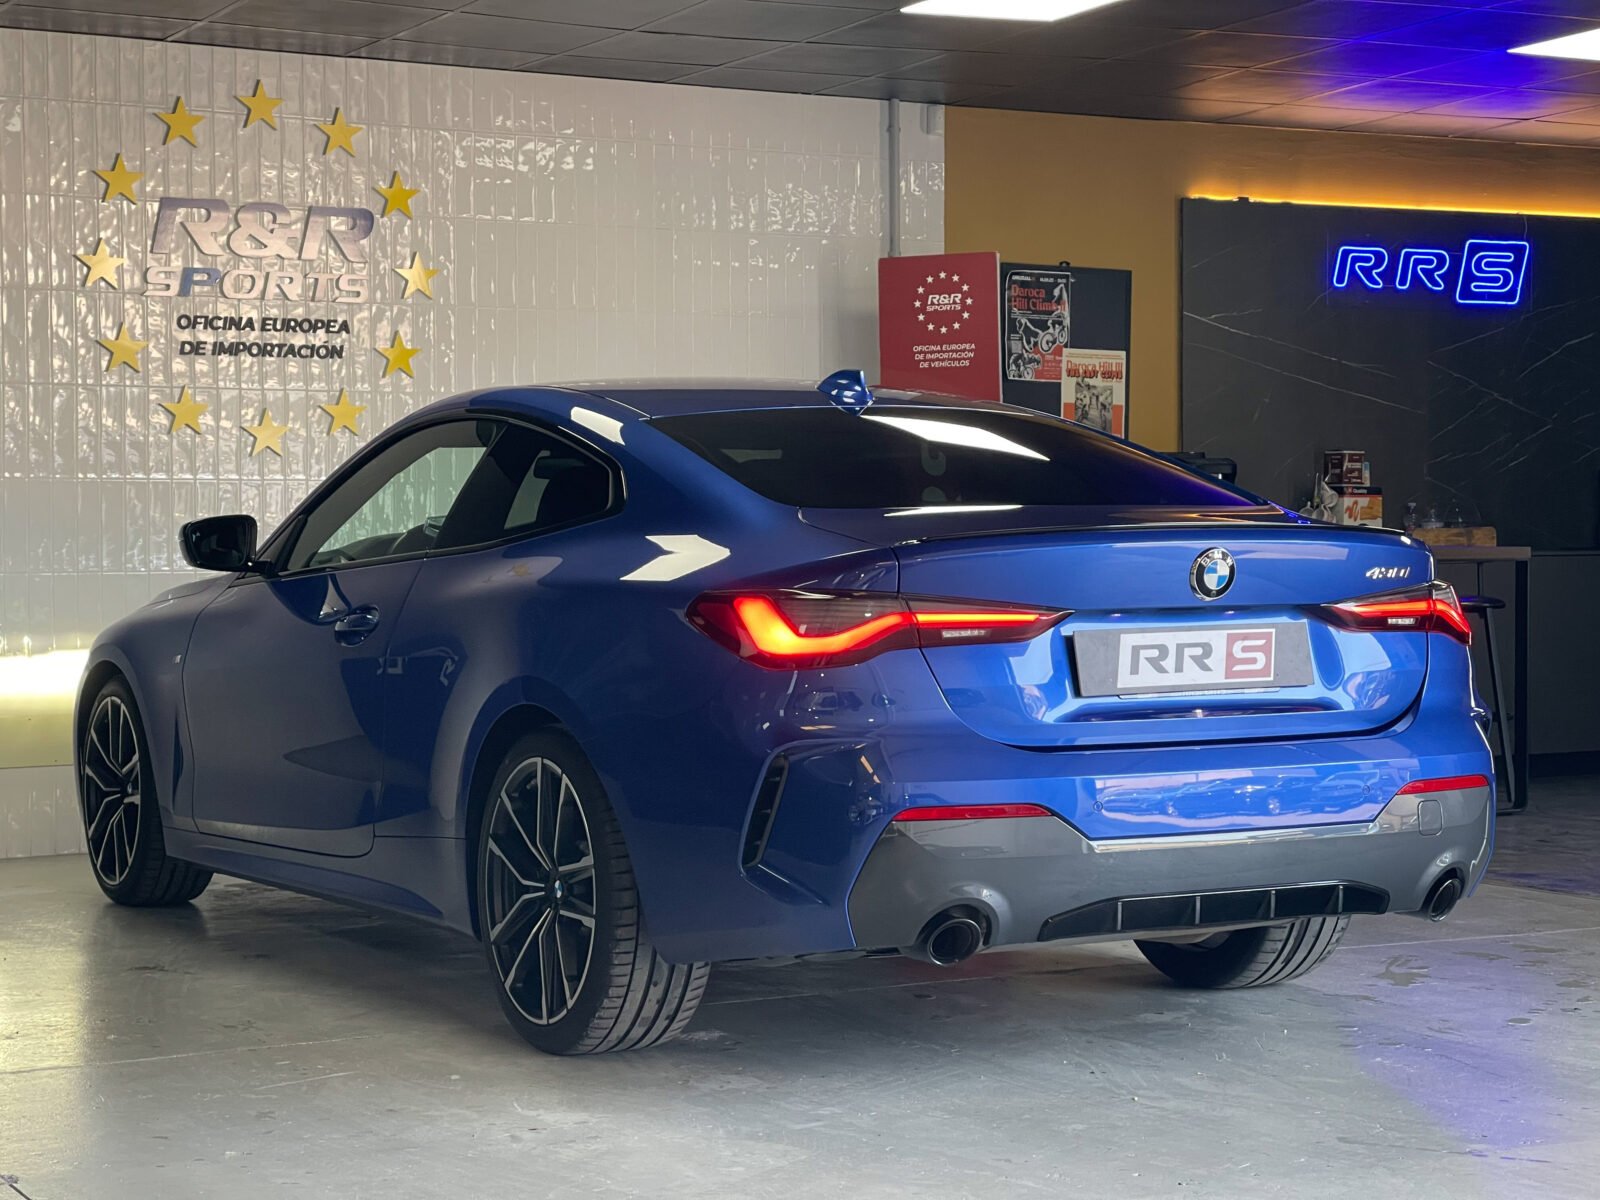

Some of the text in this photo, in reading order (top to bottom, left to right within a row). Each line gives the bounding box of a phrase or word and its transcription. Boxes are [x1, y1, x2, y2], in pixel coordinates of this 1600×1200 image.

[150, 197, 375, 263] R&R
[142, 265, 369, 304] SPORTS
[1011, 284, 1045, 298] Daroca
[927, 293, 962, 305] R&R
[1011, 297, 1028, 310] Hill
[926, 303, 962, 312] SPORTS
[176, 313, 351, 335] OFICINA EUROPEA
[179, 340, 345, 360] DE IMPORTACIÓN
[912, 343, 976, 352] OFICINA EUROPEA
[925, 351, 975, 360] IMPORTACIÓN
[930, 360, 970, 368] VEHÍCULOS
[1201, 550, 1234, 567] BMW
